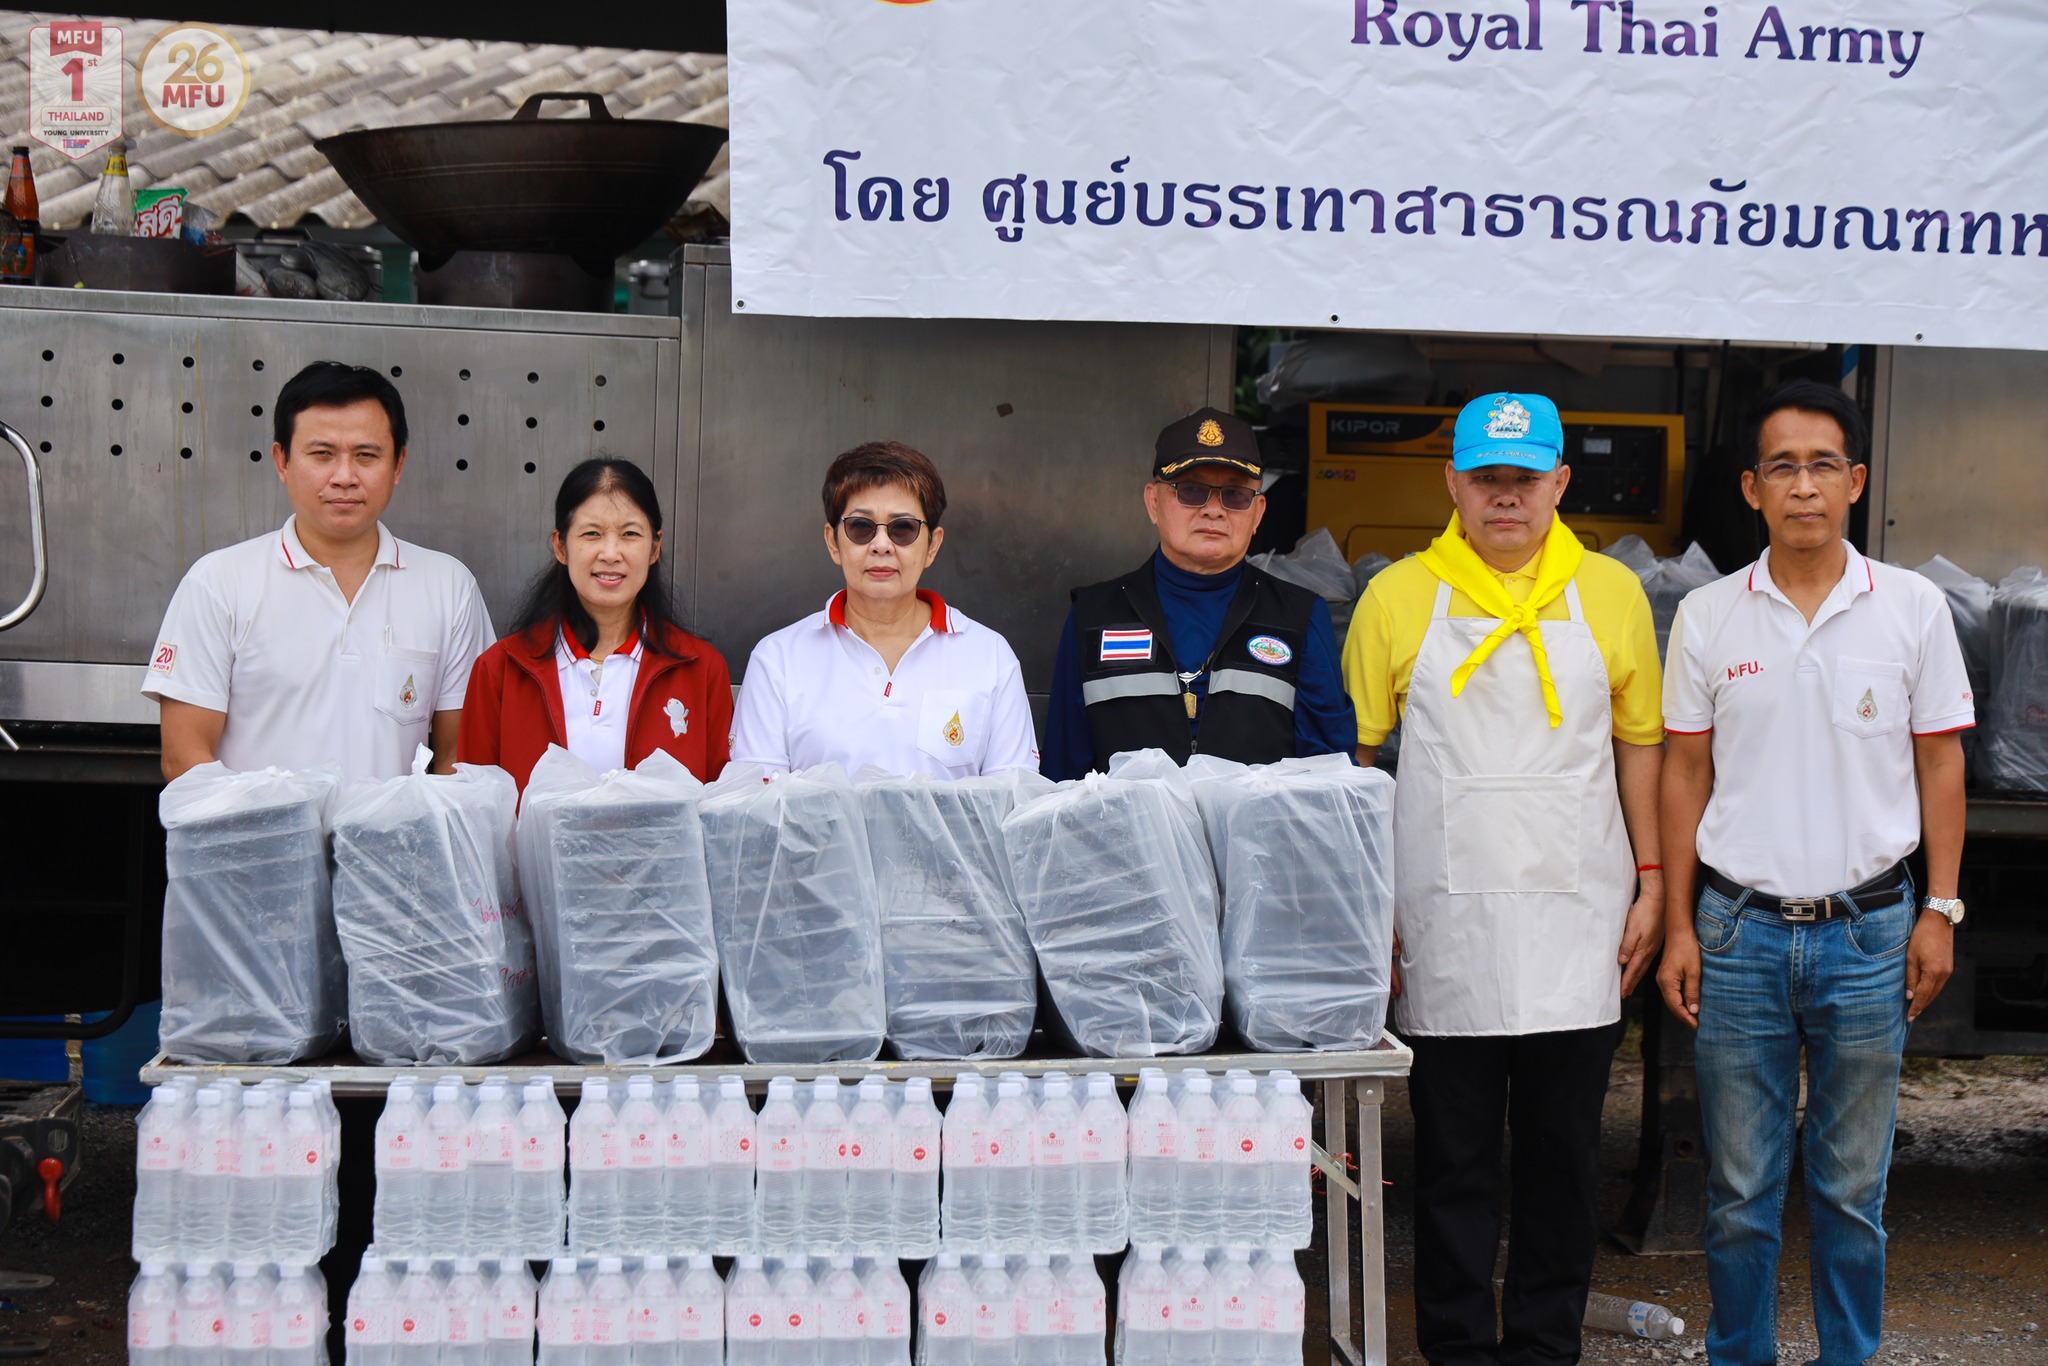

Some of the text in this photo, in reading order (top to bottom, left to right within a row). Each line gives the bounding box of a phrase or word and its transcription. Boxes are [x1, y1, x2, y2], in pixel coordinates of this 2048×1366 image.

[1352, 0, 1924, 79] Royal Thai Army
[822, 150, 951, 222] โดย
[1330, 419, 1400, 434] KIPOR
[156, 646, 174, 664] 20
